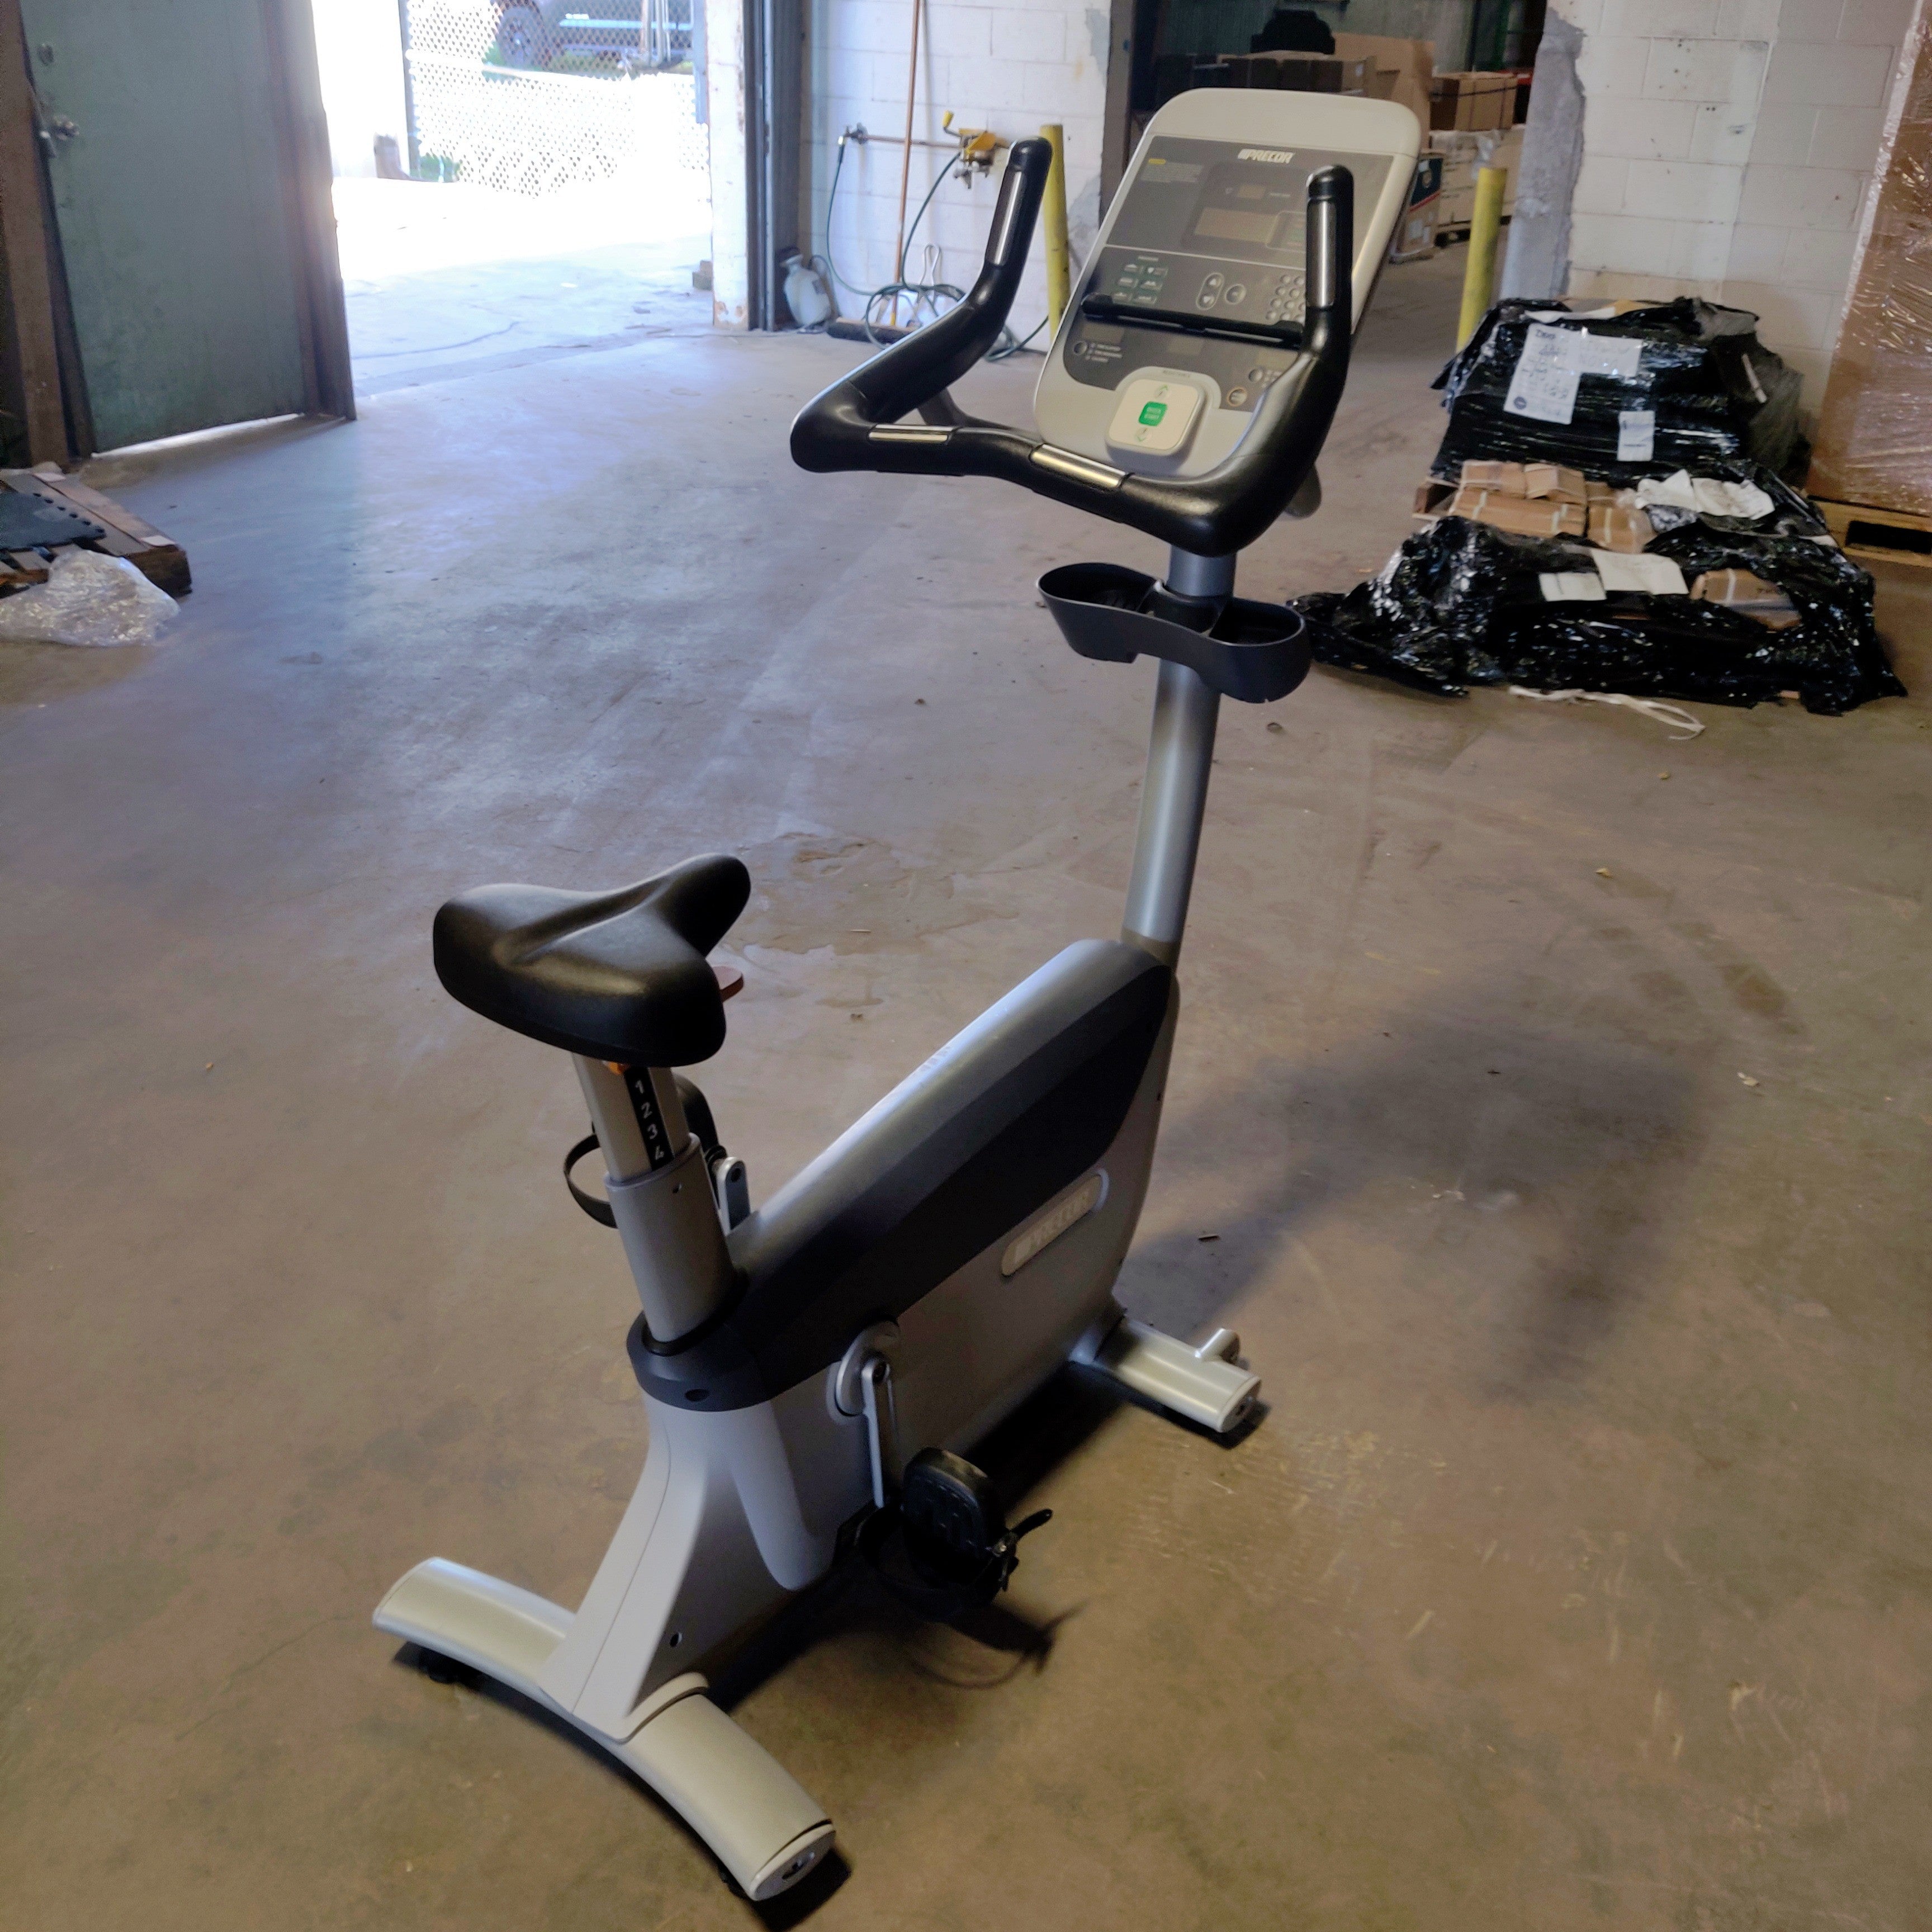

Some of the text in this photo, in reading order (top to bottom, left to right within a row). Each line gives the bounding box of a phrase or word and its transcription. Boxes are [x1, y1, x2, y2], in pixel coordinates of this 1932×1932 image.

[1246, 149, 1295, 164] PRECOR
[635, 1079, 644, 1094] 1
[641, 1102, 653, 1119] 2
[647, 1123, 659, 1140] 3
[654, 1145, 665, 1161] 4
